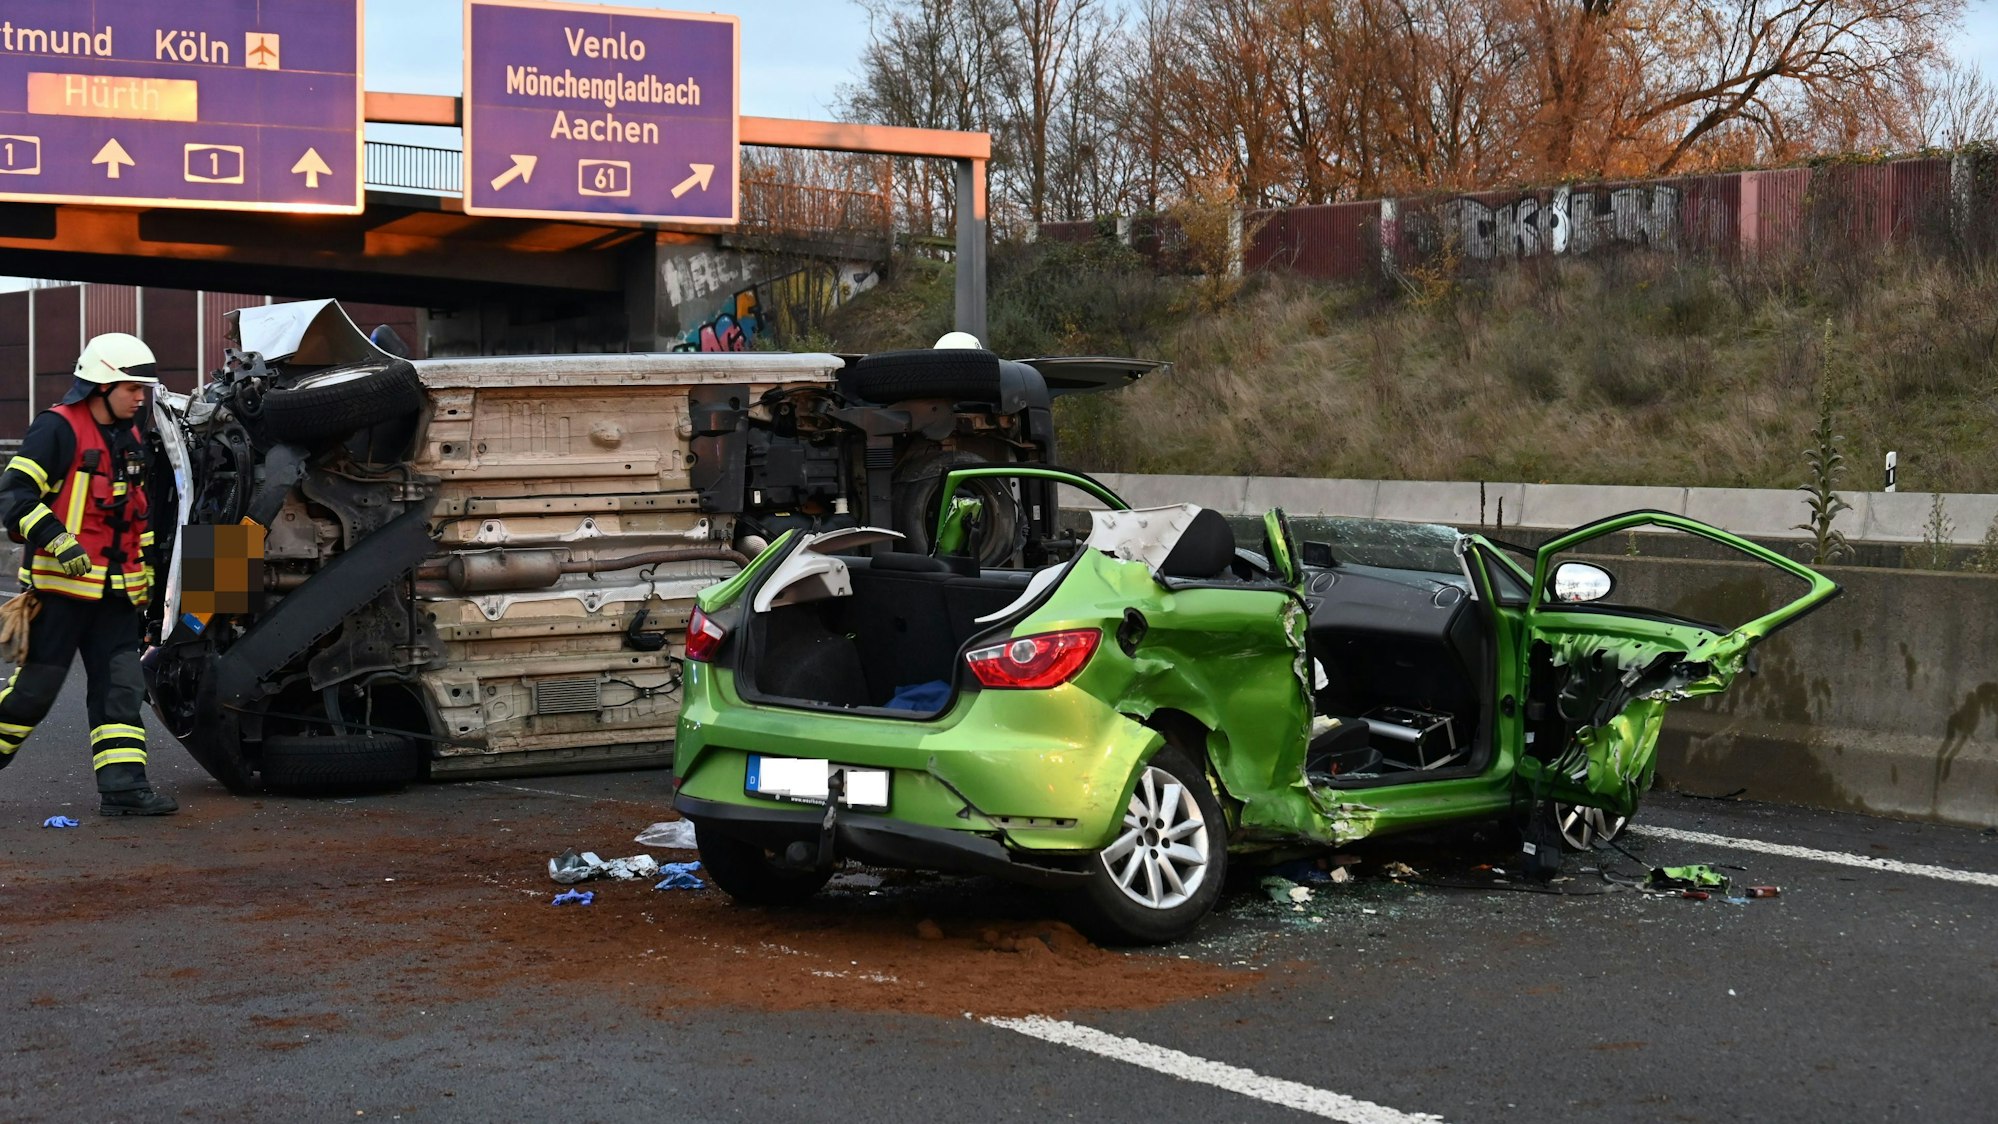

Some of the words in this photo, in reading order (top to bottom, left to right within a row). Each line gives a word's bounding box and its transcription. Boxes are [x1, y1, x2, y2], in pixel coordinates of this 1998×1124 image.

[0, 21, 112, 57] tmund
[155, 29, 229, 64] Köln
[564, 27, 646, 61] Venlo
[65, 75, 160, 110] Hürth
[506, 65, 700, 108] Mönchengladbach
[550, 110, 659, 144] Aachen
[5, 143, 13, 166] 1
[209, 152, 218, 175] 1
[594, 167, 615, 190] 61
[750, 776, 756, 785] D
